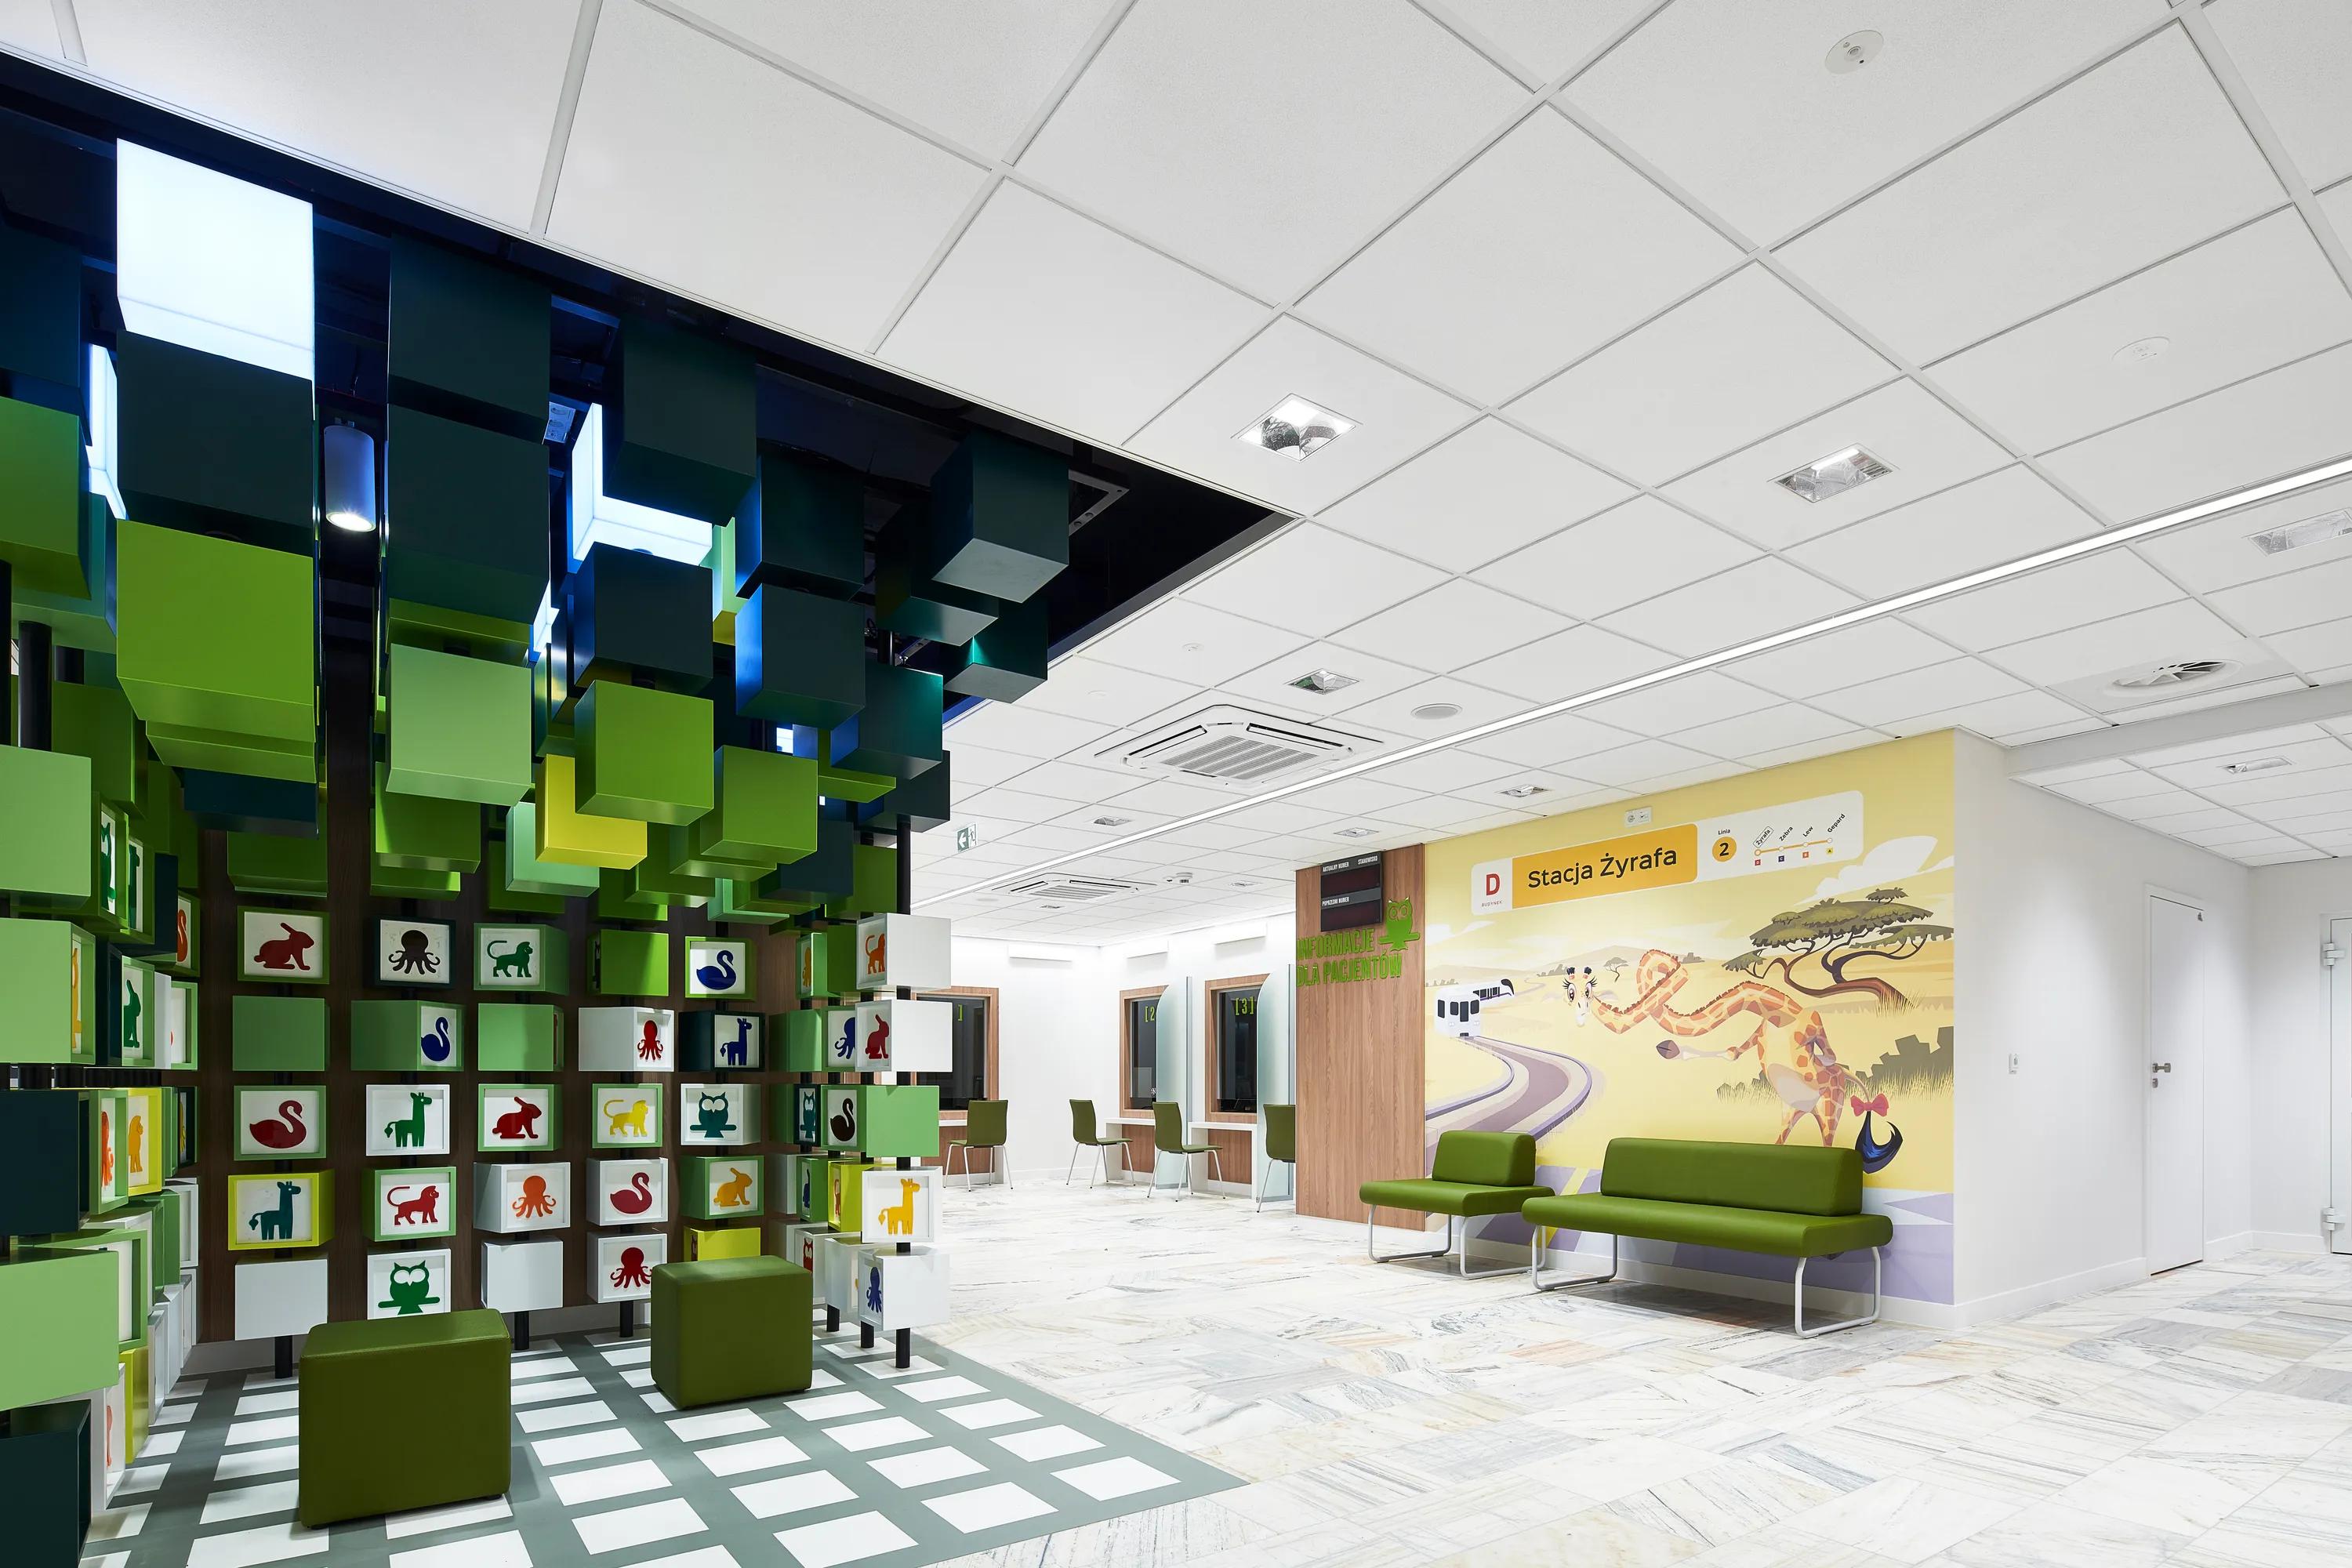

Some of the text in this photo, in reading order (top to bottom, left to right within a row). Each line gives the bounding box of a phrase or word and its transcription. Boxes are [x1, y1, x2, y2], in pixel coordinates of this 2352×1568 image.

[1802, 826, 1813, 837] Lew
[1828, 813, 1846, 833] Gepard
[1779, 826, 1793, 841] Zebra
[1719, 842, 1730, 857] 2
[1528, 848, 1677, 888] Stacja Żyrafa
[1486, 873, 1500, 895] D
[1297, 928, 1374, 960] INFORMACJE
[1297, 949, 1402, 986] DLA PACJENTÓW
[1144, 1006, 1156, 1022] [2
